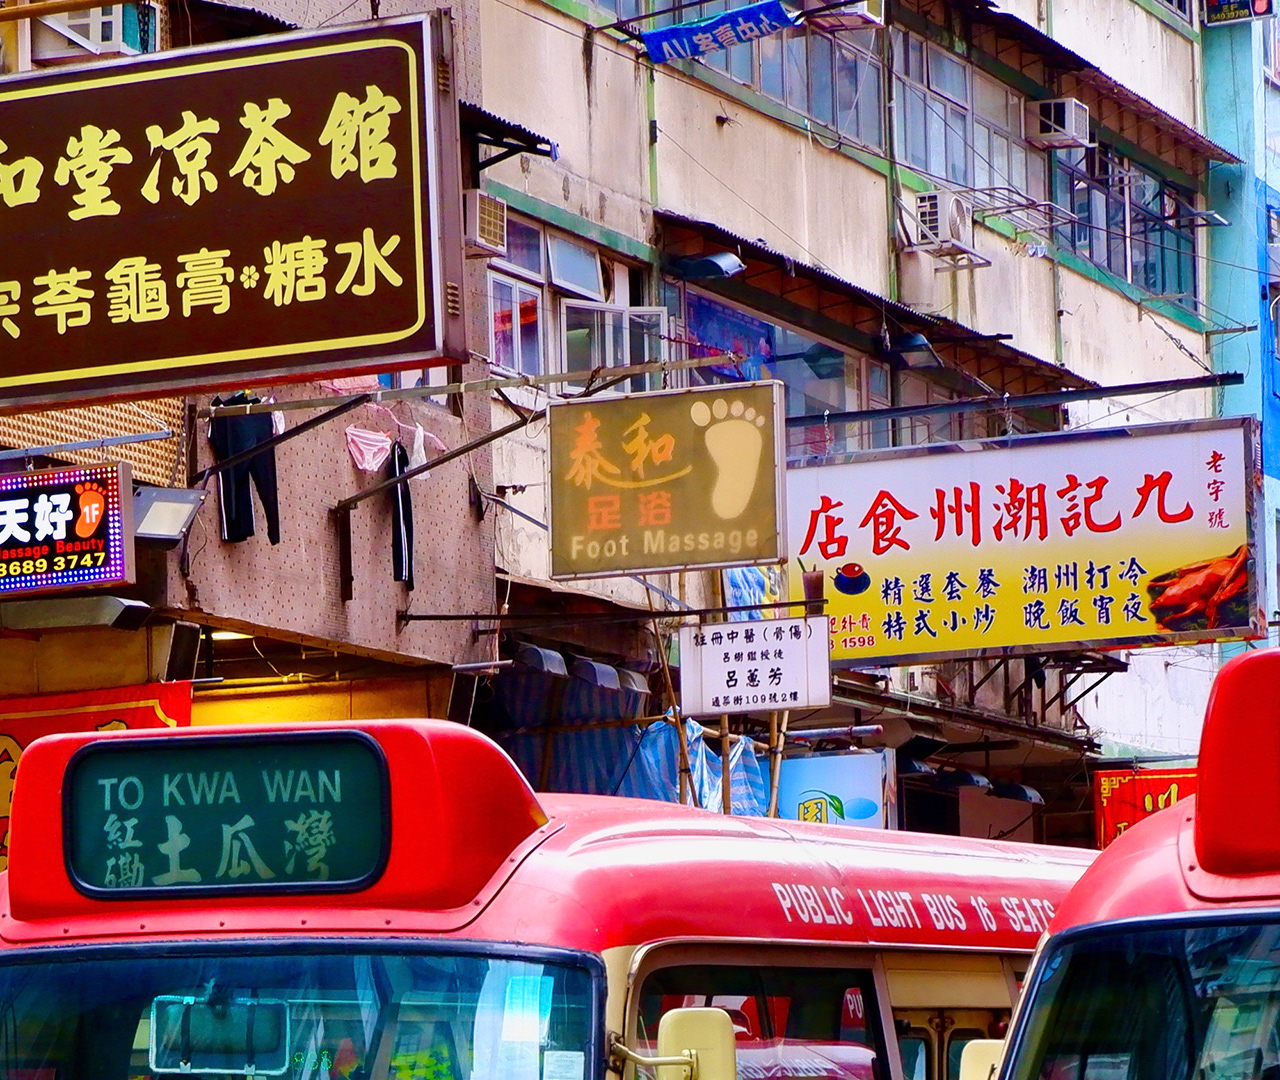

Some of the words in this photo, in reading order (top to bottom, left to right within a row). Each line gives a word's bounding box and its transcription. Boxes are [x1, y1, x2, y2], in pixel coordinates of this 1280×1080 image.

[263, 226, 404, 307] 糖水
[587, 490, 673, 532] 足浴
[1204, 449, 1230, 530] 老字號
[82, 502, 100, 525] 1F
[52, 551, 106, 572] 3747
[55, 537, 105, 554] Beauty
[570, 534, 629, 561] Foot
[643, 528, 759, 554] Massage
[881, 567, 1001, 606] 精選套餐
[1022, 556, 1149, 594] 潮州打冷
[881, 603, 997, 642] 特式小炒
[1022, 592, 1149, 631] 晚飯宵夜
[842, 635, 876, 649] 1598
[98, 776, 144, 812] TO
[162, 771, 242, 807] KWA
[262, 769, 343, 803] WAN
[150, 809, 339, 888] 土瓜灣
[771, 882, 854, 926] PUBLIC
[855, 888, 922, 930] LIGHT
[920, 893, 967, 932] BUS
[969, 895, 997, 932] 16
